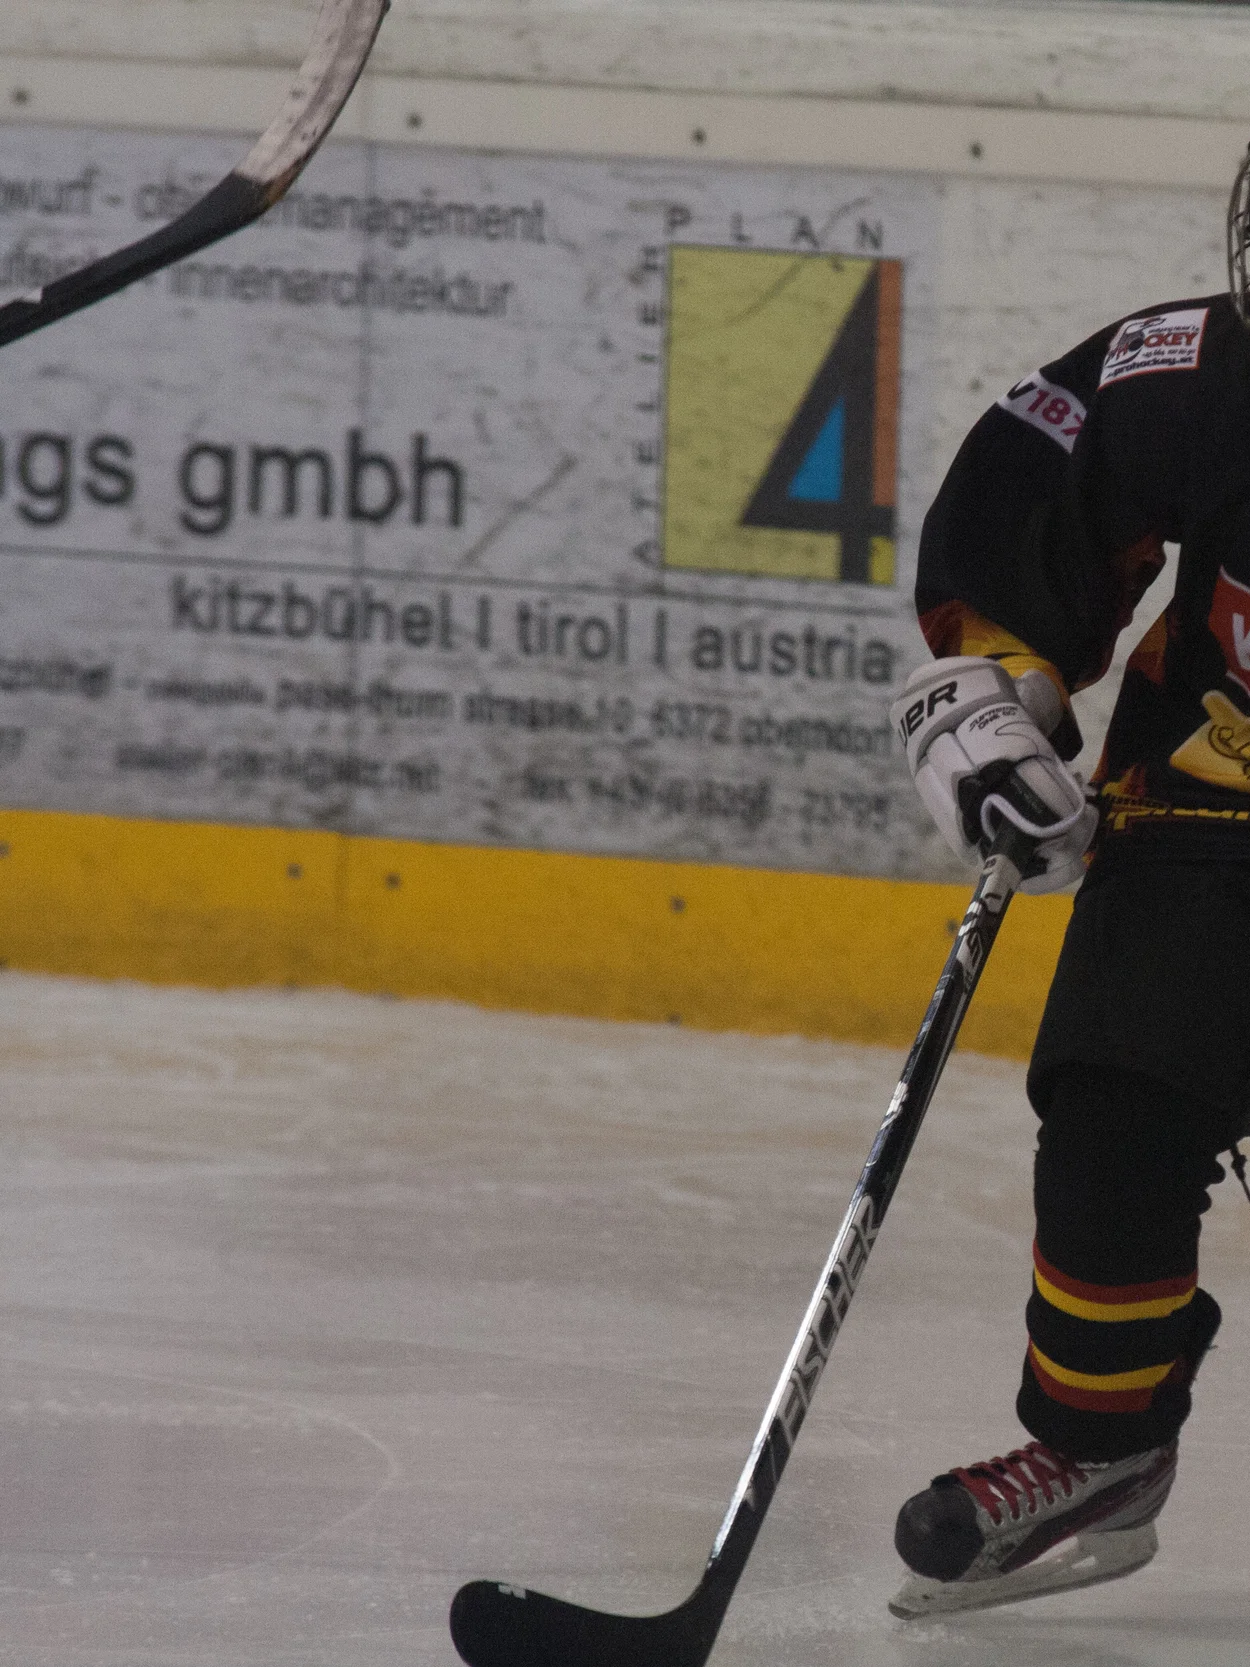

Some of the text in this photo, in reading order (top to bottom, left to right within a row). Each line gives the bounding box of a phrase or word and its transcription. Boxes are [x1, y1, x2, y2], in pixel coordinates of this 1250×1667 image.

[664, 203, 885, 251] PLAN
[0, 427, 466, 536] gs gmbh
[515, 599, 630, 666] tirol
[691, 622, 898, 686] austria
[776, 1194, 882, 1448] FISCHER
